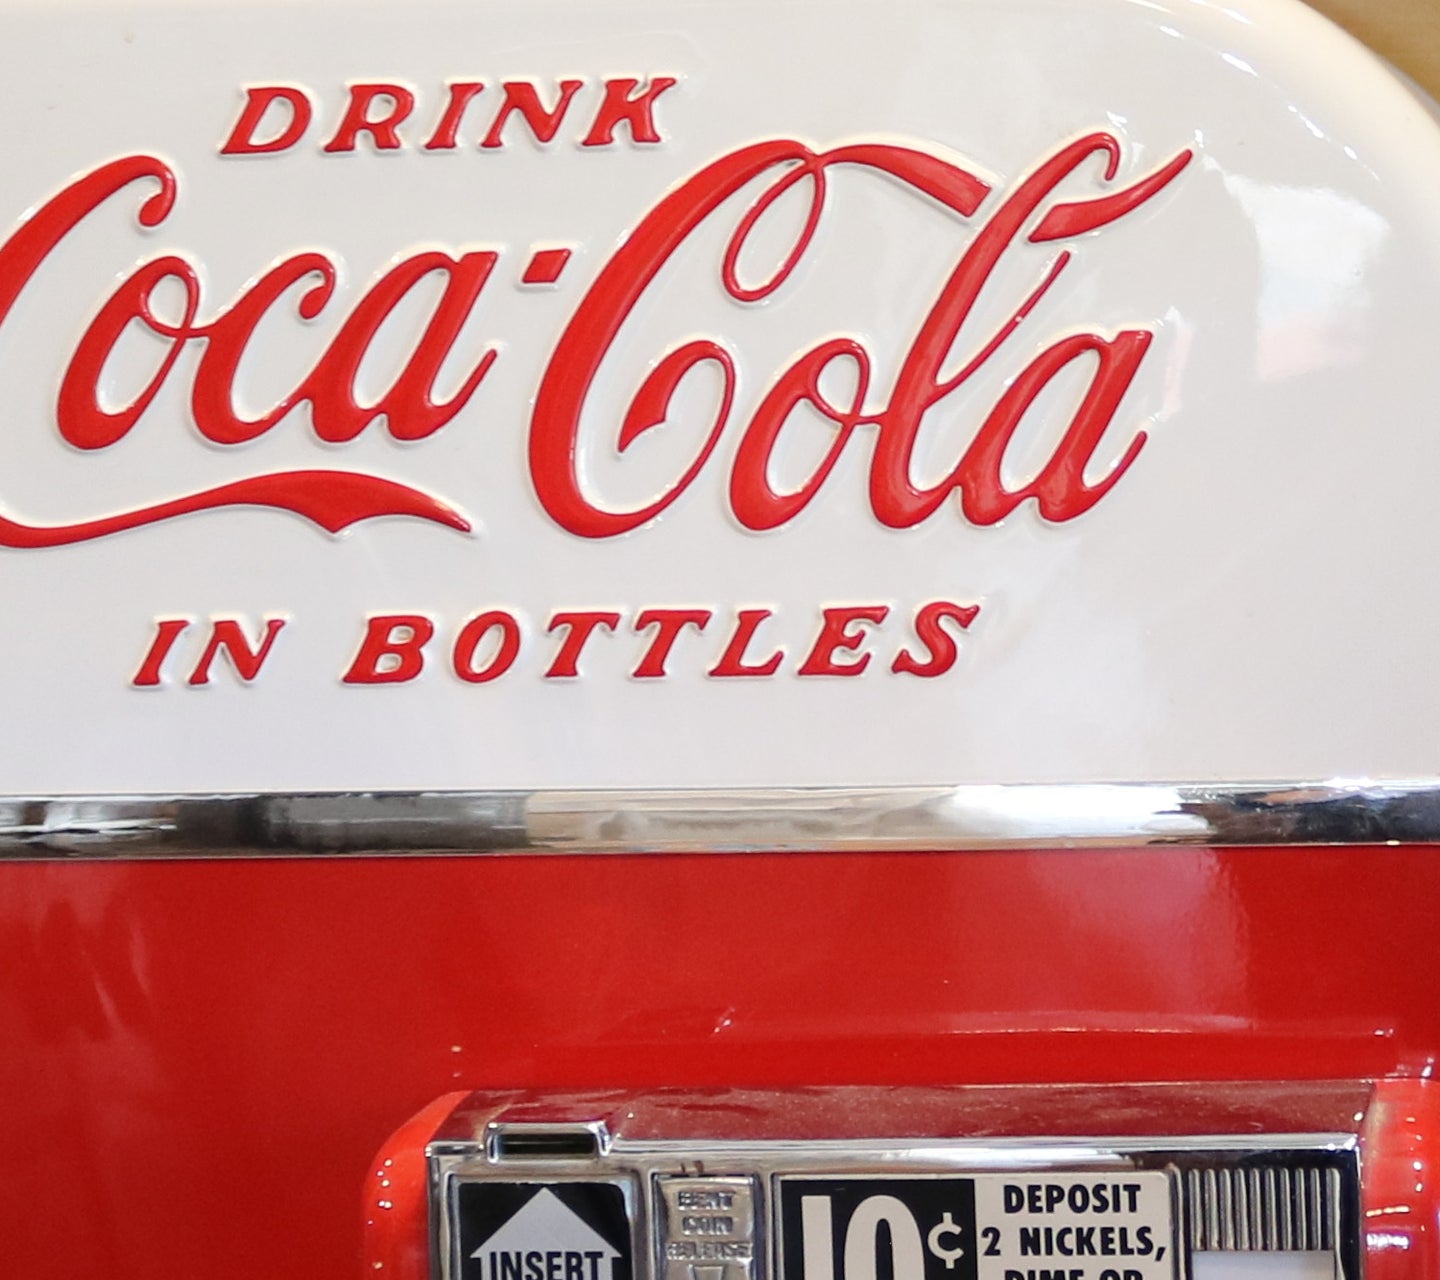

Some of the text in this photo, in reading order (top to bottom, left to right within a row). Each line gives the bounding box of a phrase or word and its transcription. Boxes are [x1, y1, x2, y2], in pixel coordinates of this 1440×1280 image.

[220, 77, 677, 155] DRINK
[132, 604, 980, 686] IN BOTTLES
[1003, 1183, 1142, 1214] DEPOSIT
[981, 1225, 1167, 1262] 2 NICKELS,
